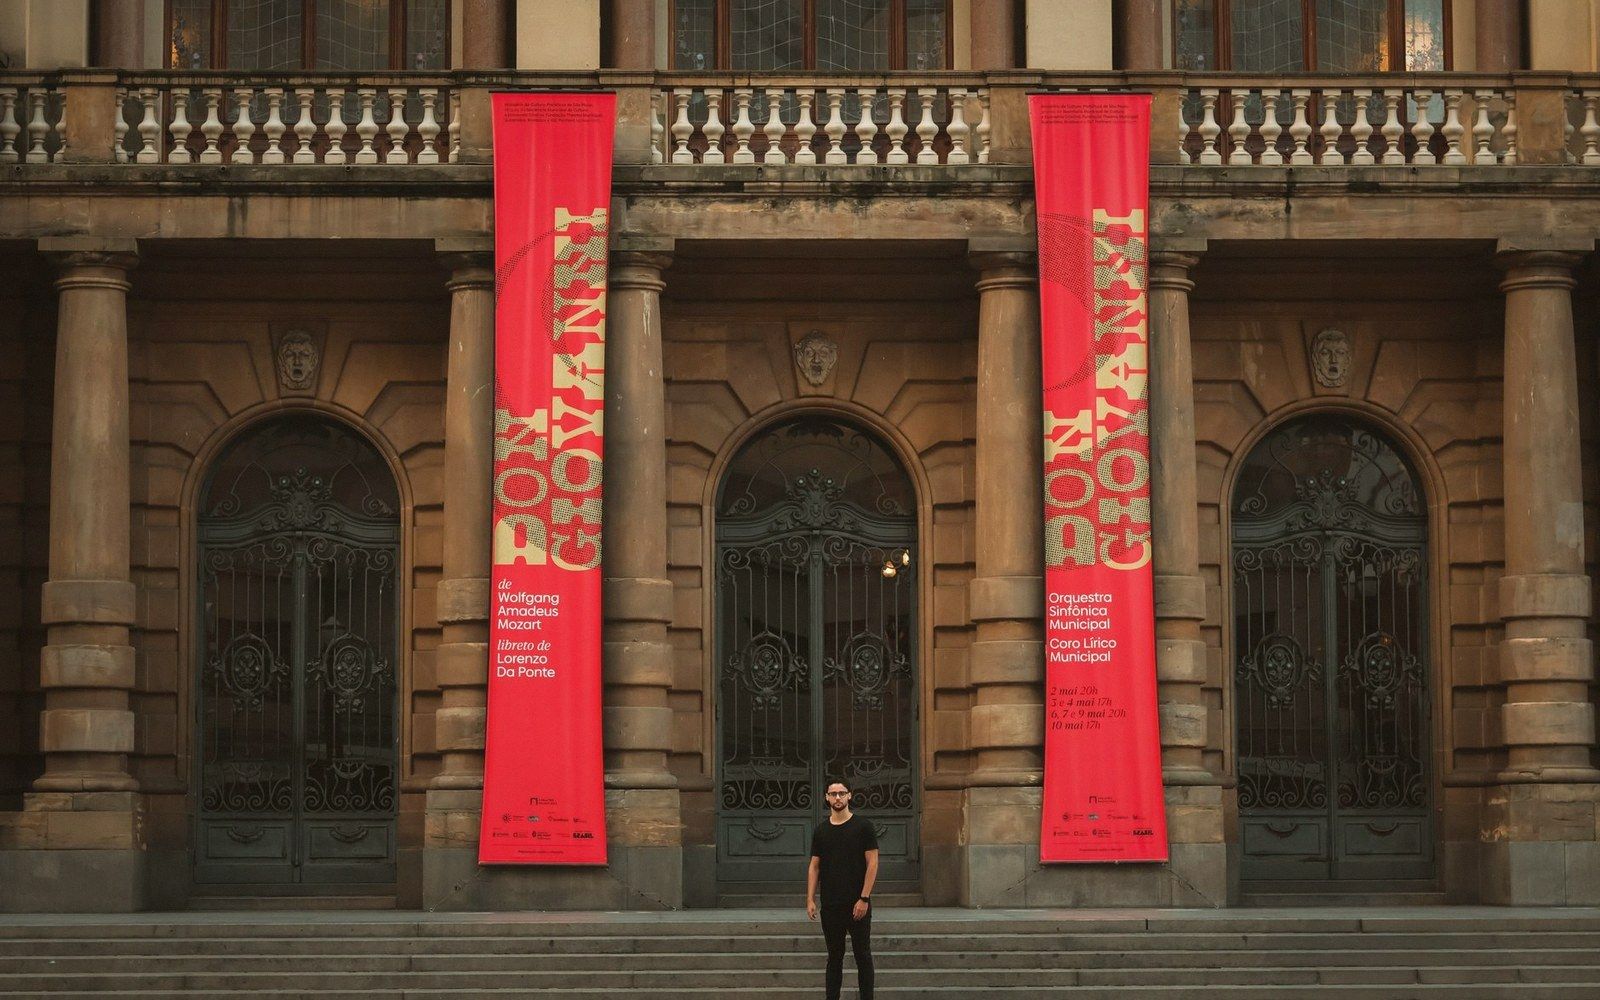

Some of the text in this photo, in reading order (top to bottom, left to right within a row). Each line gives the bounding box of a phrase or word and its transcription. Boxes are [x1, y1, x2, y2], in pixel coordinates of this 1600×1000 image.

[552, 207, 607, 571] GIOVANNI
[1093, 208, 1151, 571] GIOVANNI
[494, 409, 548, 565] DON
[1044, 409, 1096, 566] DON
[498, 578, 512, 590] de
[498, 592, 560, 606] Wolfgang
[1049, 592, 1112, 605] Orquestra
[497, 605, 559, 617] Amadeus
[1049, 605, 1108, 617] Sinfônica
[497, 619, 542, 630] Mozart
[1049, 618, 1110, 631] Municipal
[497, 639, 551, 651] libreto de
[1050, 637, 1117, 649] Coro Lírico
[497, 653, 548, 664] Lorenzo
[1050, 651, 1111, 664] Municipal
[497, 666, 556, 677] Da Ponte
[1050, 686, 1098, 695] 2 mai 20h
[1067, 698, 1073, 706] 4
[1076, 698, 1095, 706] mai
[1098, 698, 1112, 706] 17h
[1062, 710, 1069, 718] 7
[1078, 710, 1085, 718] 9
[1087, 709, 1106, 718] mai
[1109, 709, 1126, 718] 20h
[1051, 721, 1101, 730] 10 mai 17h
